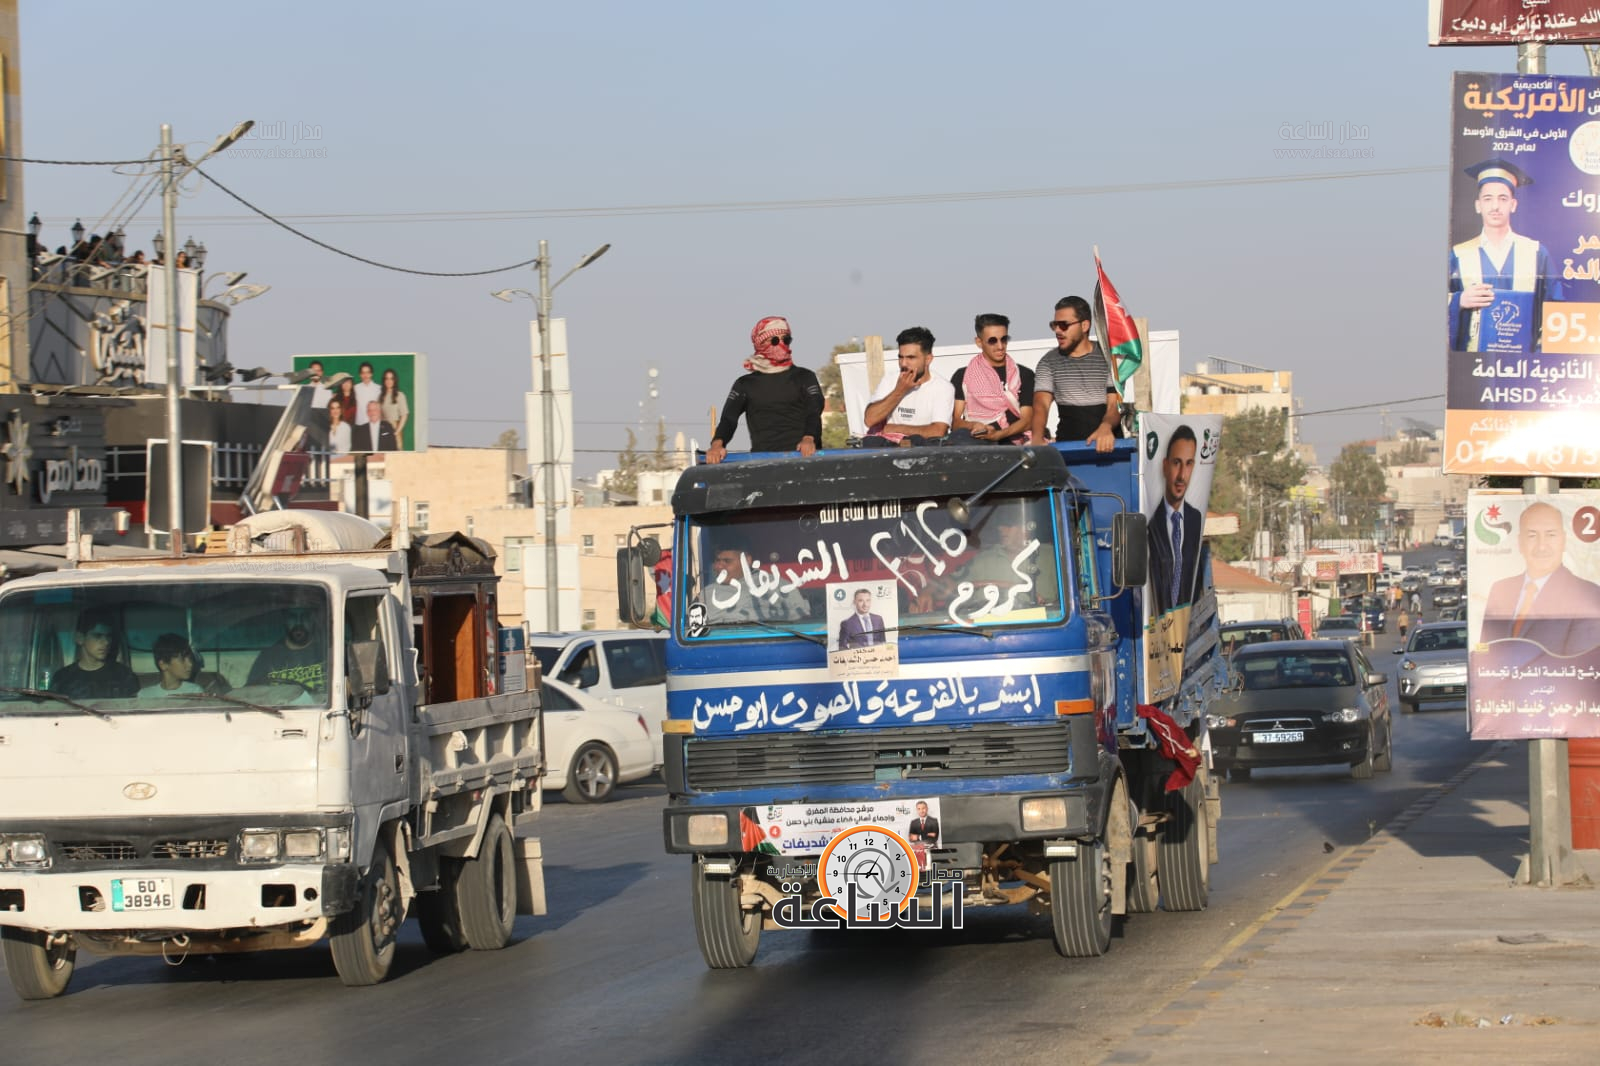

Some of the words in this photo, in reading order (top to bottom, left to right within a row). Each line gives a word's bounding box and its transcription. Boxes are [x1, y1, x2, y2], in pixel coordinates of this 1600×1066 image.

[1513, 80, 1552, 91] الأكاديمية
[1463, 82, 1585, 119] الأمريكية
[1462, 126, 1494, 138] الأوسط
[1494, 127, 1522, 139] الشرق
[1523, 129, 1539, 140] في
[1540, 128, 1567, 140] الأولى
[1492, 142, 1514, 151] 2023
[1514, 144, 1536, 155] لعام
[1472, 358, 1527, 379] العامة
[1530, 359, 1592, 383] الثانوية
[1480, 387, 1537, 403] AHSD
[820, 504, 839, 524] الله
[1581, 512, 1597, 535] 2
[1511, 666, 1541, 679] المفرق
[1542, 665, 1576, 677] قائمة
[976, 673, 1041, 713] ابشر
[693, 694, 745, 731] حسن
[734, 690, 769, 732] ابو
[1475, 699, 1515, 717] الخوالدة
[806, 807, 829, 816] المفرق
[829, 806, 855, 814] محافظة
[856, 805, 874, 814] مرشح
[786, 817, 802, 827] حسن
[138, 880, 156, 893] 60
[125, 894, 171, 908] 38946
